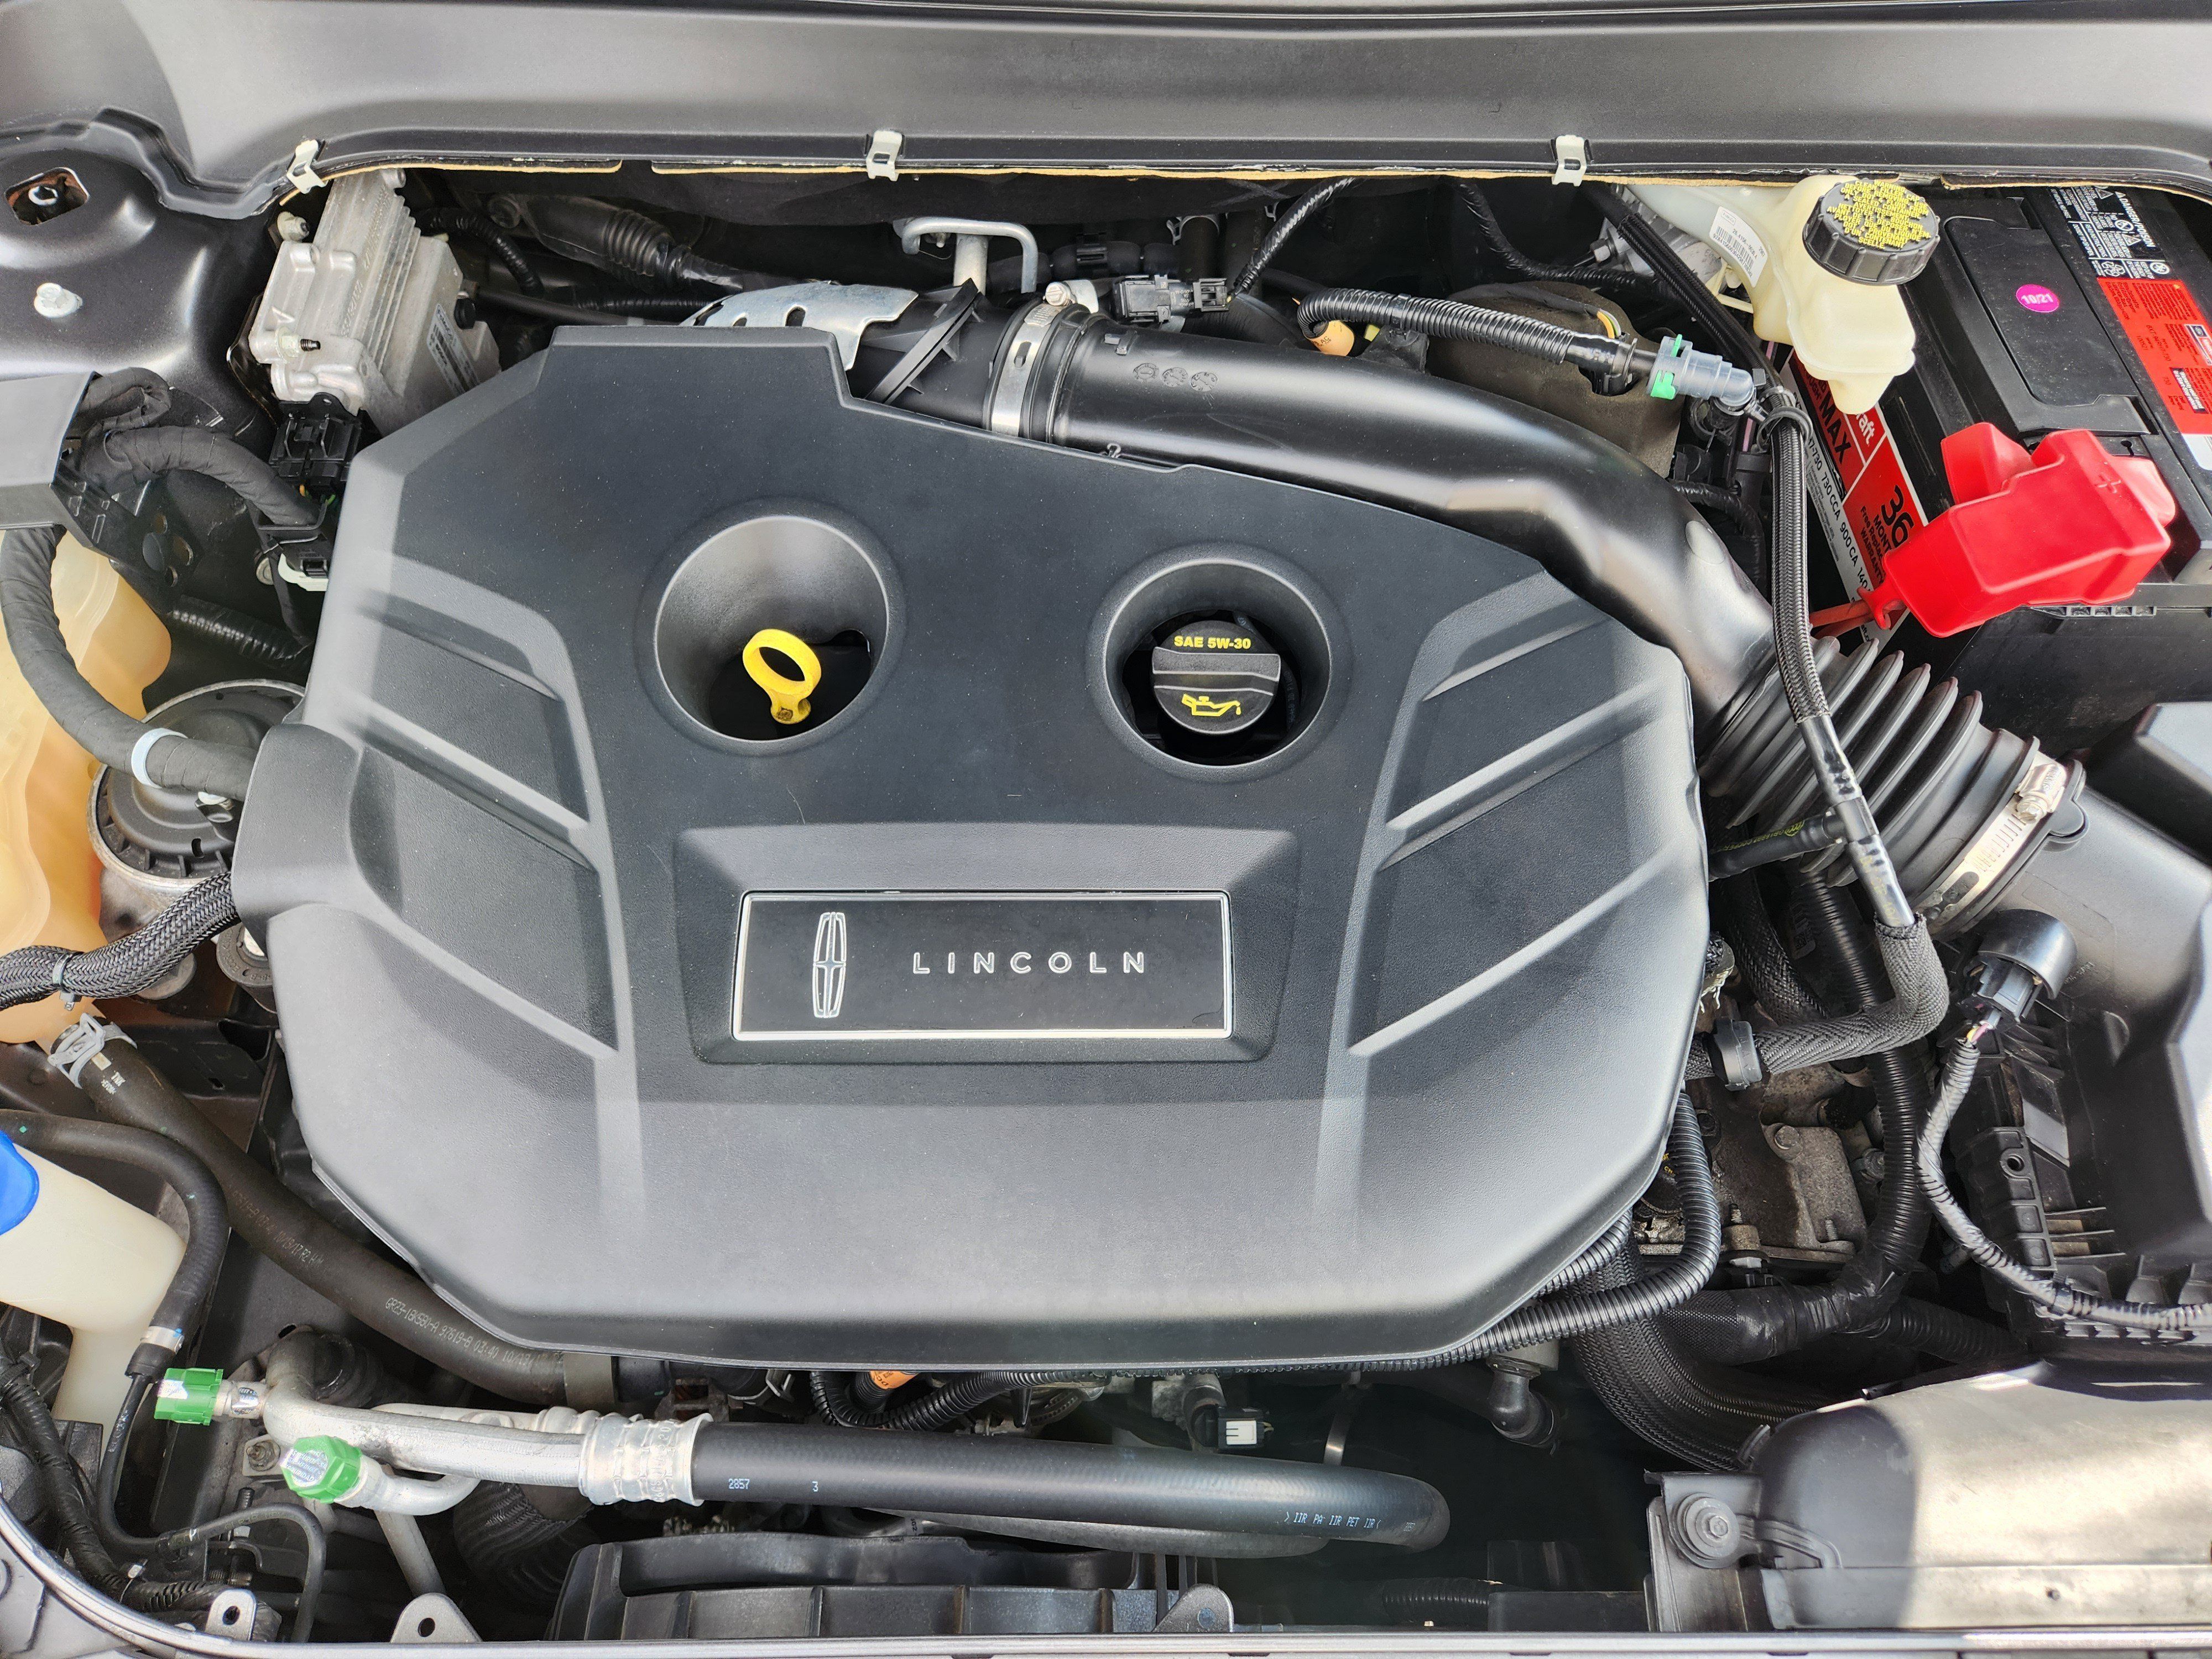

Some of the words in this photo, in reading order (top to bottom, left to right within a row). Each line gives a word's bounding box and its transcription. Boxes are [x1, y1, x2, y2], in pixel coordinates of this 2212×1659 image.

[1845, 183, 1871, 194] BEFORE
[1914, 201, 1927, 210] USE
[1855, 180, 1877, 190] CLEAN
[1880, 186, 1903, 197] FILLER
[1827, 206, 1850, 216] AVANT
[1840, 187, 1859, 196] ONLY
[1887, 199, 1906, 208] FLUID
[1910, 206, 1929, 216] FROM
[1853, 196, 1879, 207] SEALED
[1834, 213, 1860, 225] PLOYER
[1864, 221, 1877, 229] QUE
[1894, 229, 1921, 242] LIQUIDE
[1838, 203, 1873, 216] NETTOYER
[1891, 216, 1923, 232] BOUCHON
[2119, 198, 2155, 247] DANGER/POISON
[1843, 221, 1858, 229] DOT
[1869, 227, 1908, 243] PROVENANT
[1865, 232, 1905, 248] CONTENANT
[2021, 294, 2054, 304] 10/21
[1818, 390, 1852, 465] MAX
[1821, 474, 1832, 494] 730
[1828, 495, 1841, 520] CCA
[1839, 521, 1852, 548] 900
[1849, 546, 1859, 567] CA
[1860, 505, 1871, 528] Free
[1881, 484, 1915, 548] 36
[1174, 635, 1203, 649] SAE
[1207, 636, 1251, 650] 5W-30
[913, 951, 1146, 974] LINCOLN
[728, 1478, 750, 1490] 2857
[812, 1480, 819, 1492] 3
[1293, 1512, 1308, 1524] IIR
[1329, 1515, 1343, 1526] IIR
[1346, 1516, 1360, 1527] PET
